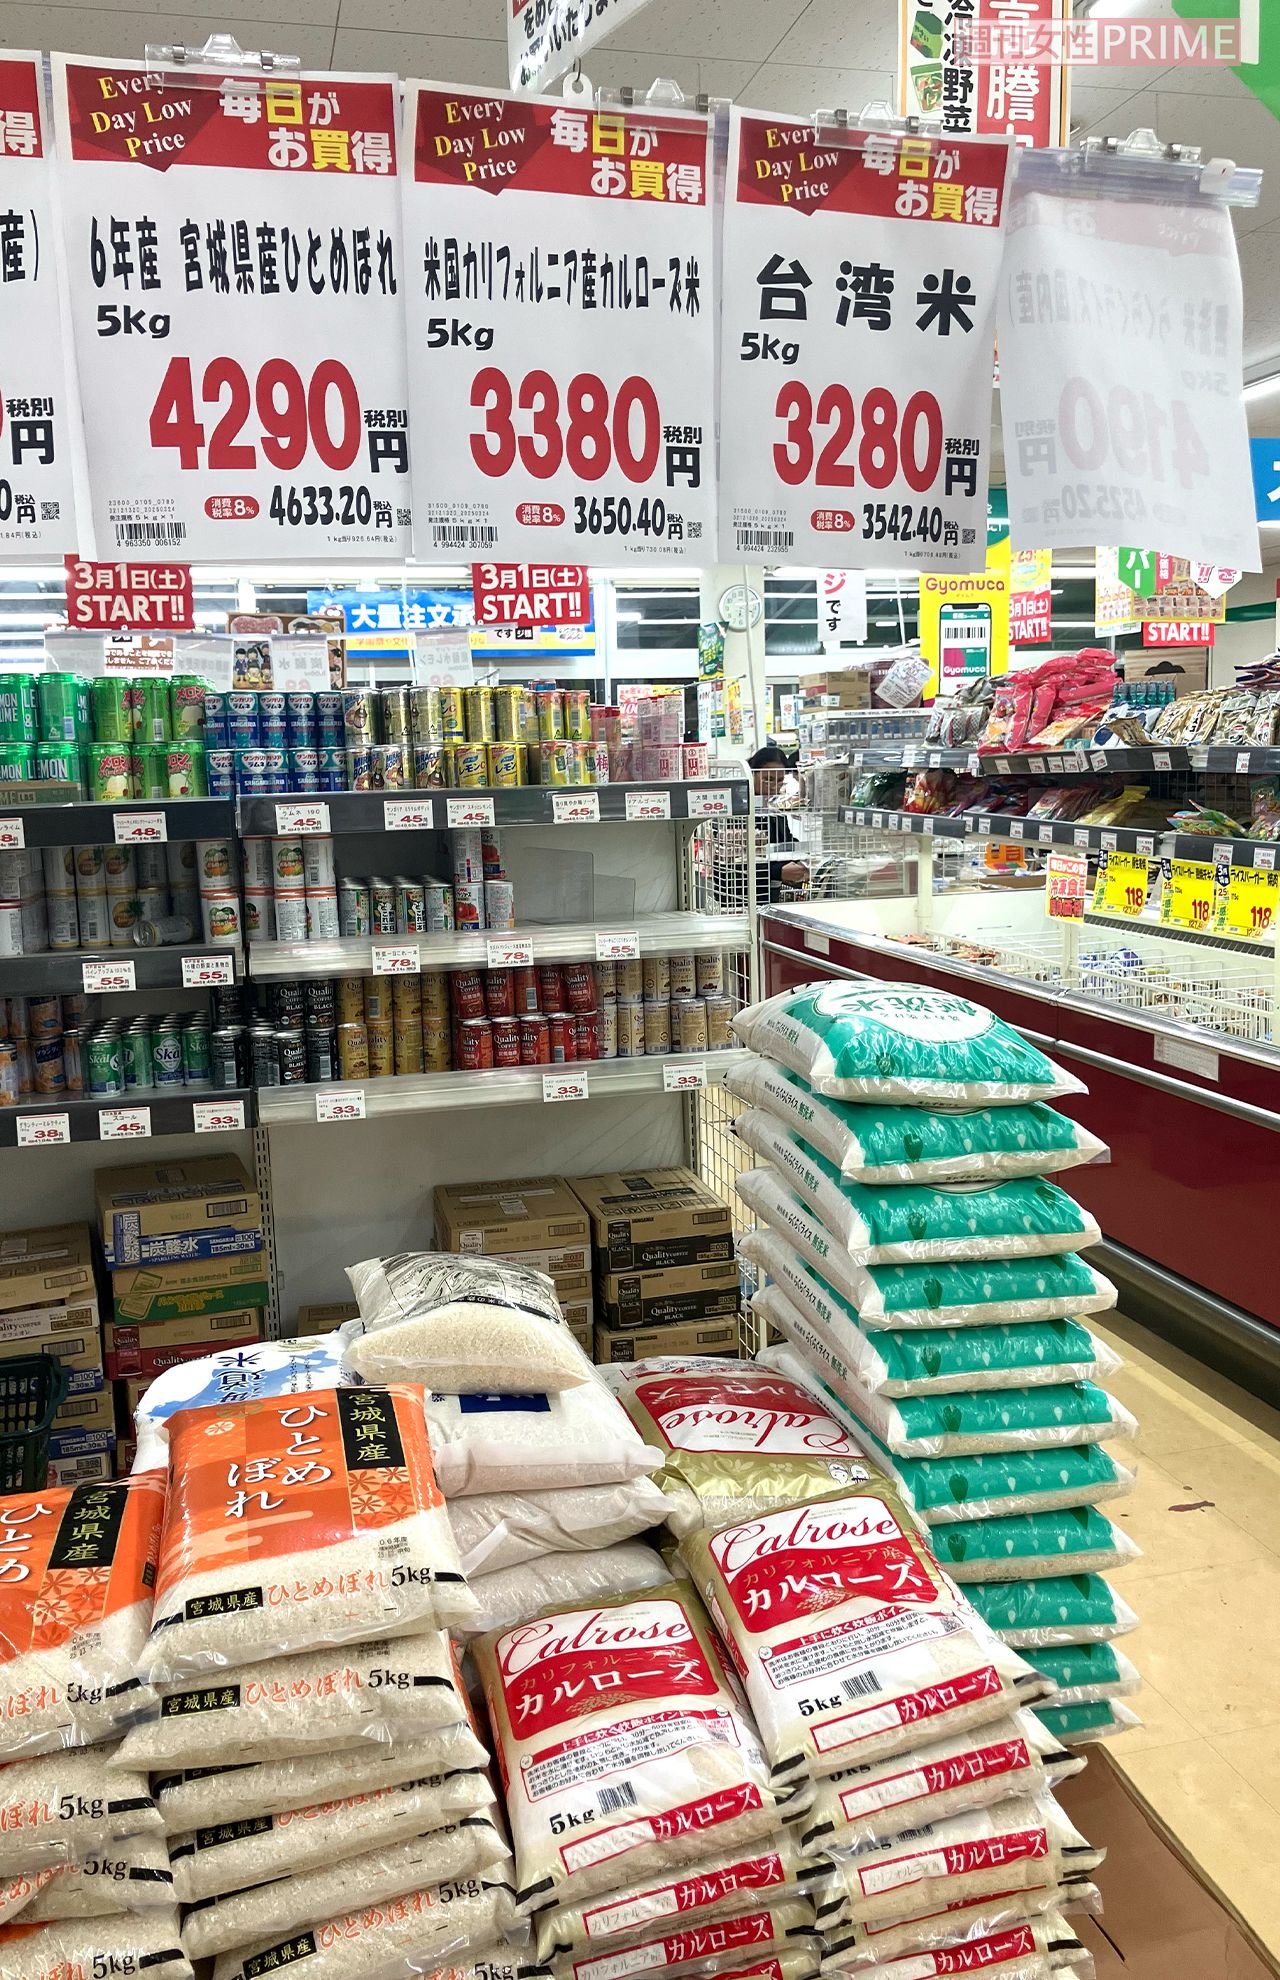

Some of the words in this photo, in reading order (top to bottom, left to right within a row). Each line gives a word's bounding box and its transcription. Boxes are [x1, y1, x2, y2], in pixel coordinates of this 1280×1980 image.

[97, 71, 166, 99] Every
[91, 109, 136, 134] Day
[143, 97, 192, 123] Low
[219, 78, 341, 125] 毎日が
[445, 100, 505, 124] Every
[125, 132, 185, 159] Price
[434, 134, 474, 158] Day
[481, 127, 526, 149] Low
[550, 109, 658, 156] 毎日が
[767, 127, 820, 149] Every
[267, 127, 393, 174] お買得
[755, 157, 793, 180] Day
[799, 149, 839, 172] Low
[862, 136, 961, 179] 毎日が
[464, 158, 517, 182] Price
[591, 157, 703, 203] お買得
[781, 178, 830, 202] Price
[895, 180, 998, 225] お買得
[91, 215, 162, 290] 6年産
[179, 217, 398, 295] 宮城県産ひとめぼれ
[424, 236, 700, 317] 米国カリフォルニア産カルロース米
[97, 304, 170, 338] 5kg
[427, 318, 494, 350] 5kg
[740, 332, 800, 365] 5kg
[6, 397, 54, 417] 税別
[149, 357, 361, 471] 4290
[364, 409, 408, 428] 税別
[470, 367, 661, 483] 3380
[664, 425, 702, 445] 税別
[773, 380, 944, 492] 3280
[11, 420, 54, 465] 円
[368, 431, 409, 473] 円
[945, 438, 979, 456] 税別
[665, 446, 701, 488] 円
[945, 457, 977, 496] 円
[14, 494, 36, 505] 税込
[212, 498, 232, 508] 消費
[213, 508, 233, 518] 税率
[234, 499, 254, 516] 8%
[270, 486, 371, 526] 4633.20
[373, 500, 392, 510] 税込
[522, 505, 541, 515] 消費
[17, 505, 36, 523] 円
[376, 511, 393, 528] 円
[522, 515, 541, 524] 税率
[542, 506, 561, 523] 8%
[574, 496, 666, 536] 3650.40
[667, 513, 683, 523] 税込
[816, 511, 833, 521] 消費
[816, 521, 833, 530] 税率
[834, 513, 851, 529] 8%
[862, 503, 942, 543] 3542.40
[944, 521, 959, 530] 税込
[668, 523, 683, 540] 円
[943, 530, 958, 546] 円
[74, 563, 186, 589] 3月1日(土)
[480, 562, 584, 589] 3月1日(土)
[925, 577, 1005, 595] Gyomuca
[76, 594, 185, 622] START!!
[483, 592, 581, 620] START!!
[1148, 623, 1210, 642] START!!
[944, 666, 986, 677] Gyomuca
[1125, 886, 1144, 908] 118
[1192, 899, 1210, 922] 118
[1250, 906, 1272, 929] 118
[149, 1237, 199, 1258] 炭酸水
[642, 1250, 669, 1262] Quality
[651, 1306, 678, 1317] Quality
[665, 1313, 684, 1321] BLACK
[349, 1393, 391, 1462] 宮城県産
[665, 1409, 849, 1454] Calrose
[63, 1490, 117, 1561] 宮城県産
[722, 1509, 902, 1575] Calrose
[191, 1590, 259, 1615] 宮城県産
[267, 1569, 388, 1606] ひとめぼれ
[391, 1564, 431, 1587] 5kg
[743, 1557, 923, 1617] カルローズ
[504, 1611, 690, 1677] Calrose
[67, 1682, 103, 1704] 5kg
[166, 1688, 238, 1714] 宮城県産
[244, 1667, 365, 1706] ひとめぼれ
[368, 1669, 410, 1690] 5kg
[516, 1659, 704, 1725] カルローズ
[798, 1692, 842, 1717] 5kg
[902, 1667, 999, 1724] カルローズ
[928, 1740, 1028, 1792] カルローズ
[59, 1794, 104, 1820] 5kg
[549, 1807, 594, 1835] 5kg
[655, 1783, 759, 1839] カルローズ
[949, 1831, 1047, 1874] カルローズ
[679, 1851, 781, 1908] カルローズ
[248, 1939, 312, 1972] 宮城県産
[317, 1890, 434, 1949] ひとめぼれ
[438, 1879, 480, 1903] 5kg
[669, 1916, 770, 1961] カルローズ
[937, 1928, 1034, 1973] カルローズ
[92, 1953, 136, 1980] 5kg
